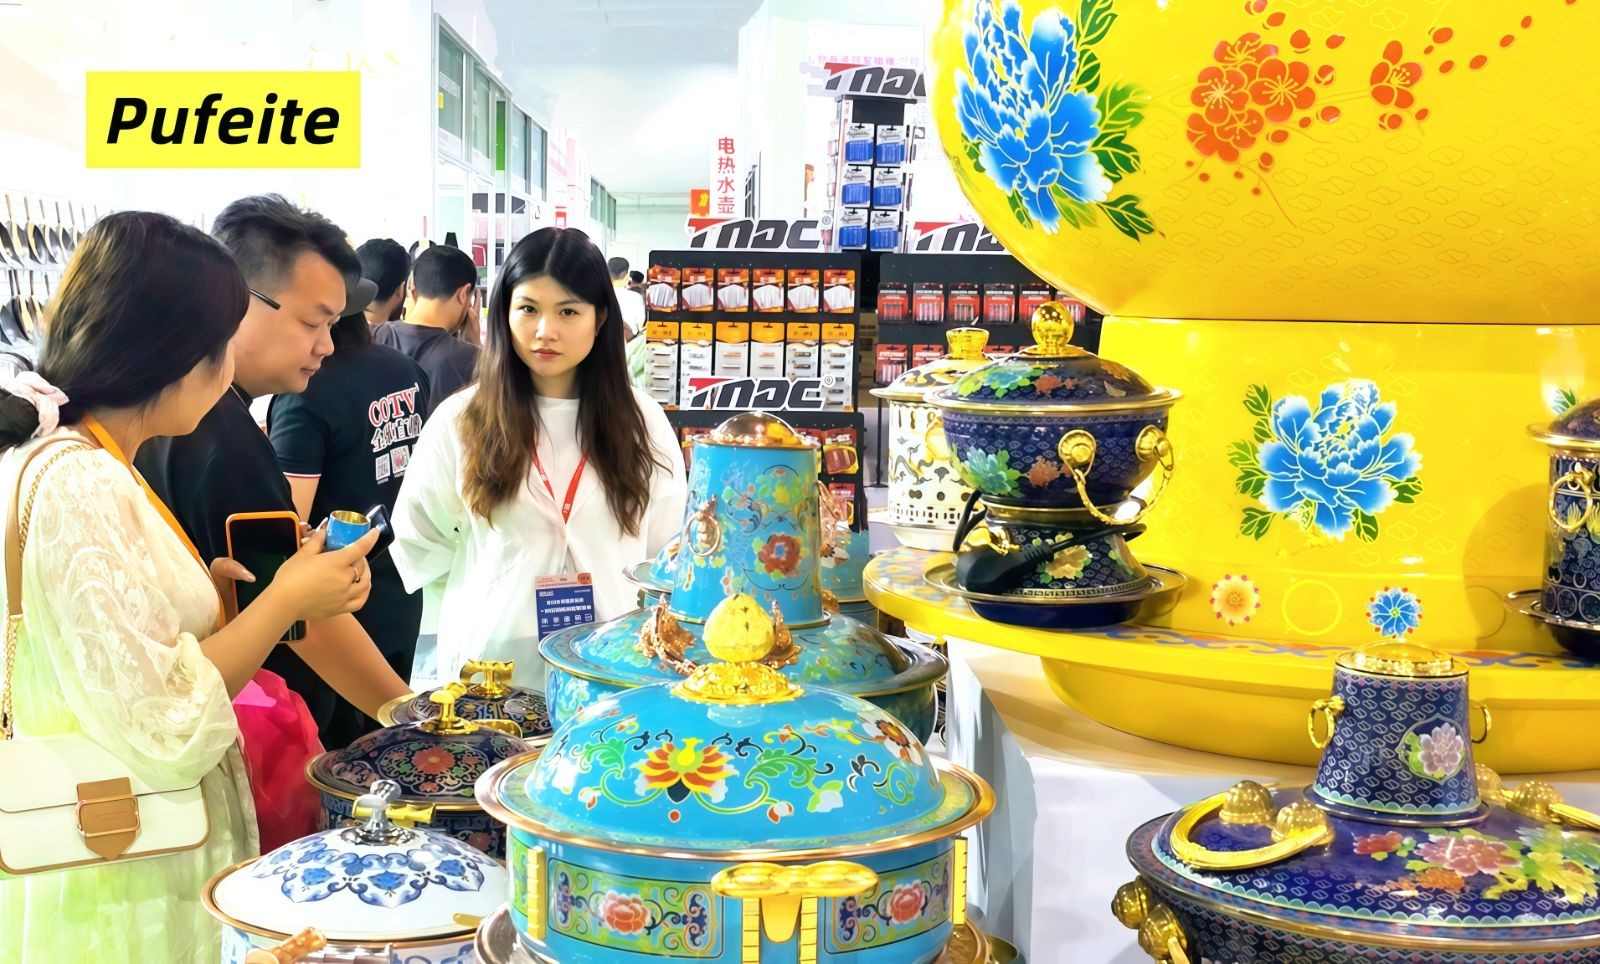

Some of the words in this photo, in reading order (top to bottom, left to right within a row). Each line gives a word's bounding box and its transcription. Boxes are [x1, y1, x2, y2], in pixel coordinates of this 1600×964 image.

[717, 136, 736, 214] 电热水壶
[913, 222, 1005, 251] TND
[368, 387, 417, 427] COTV
